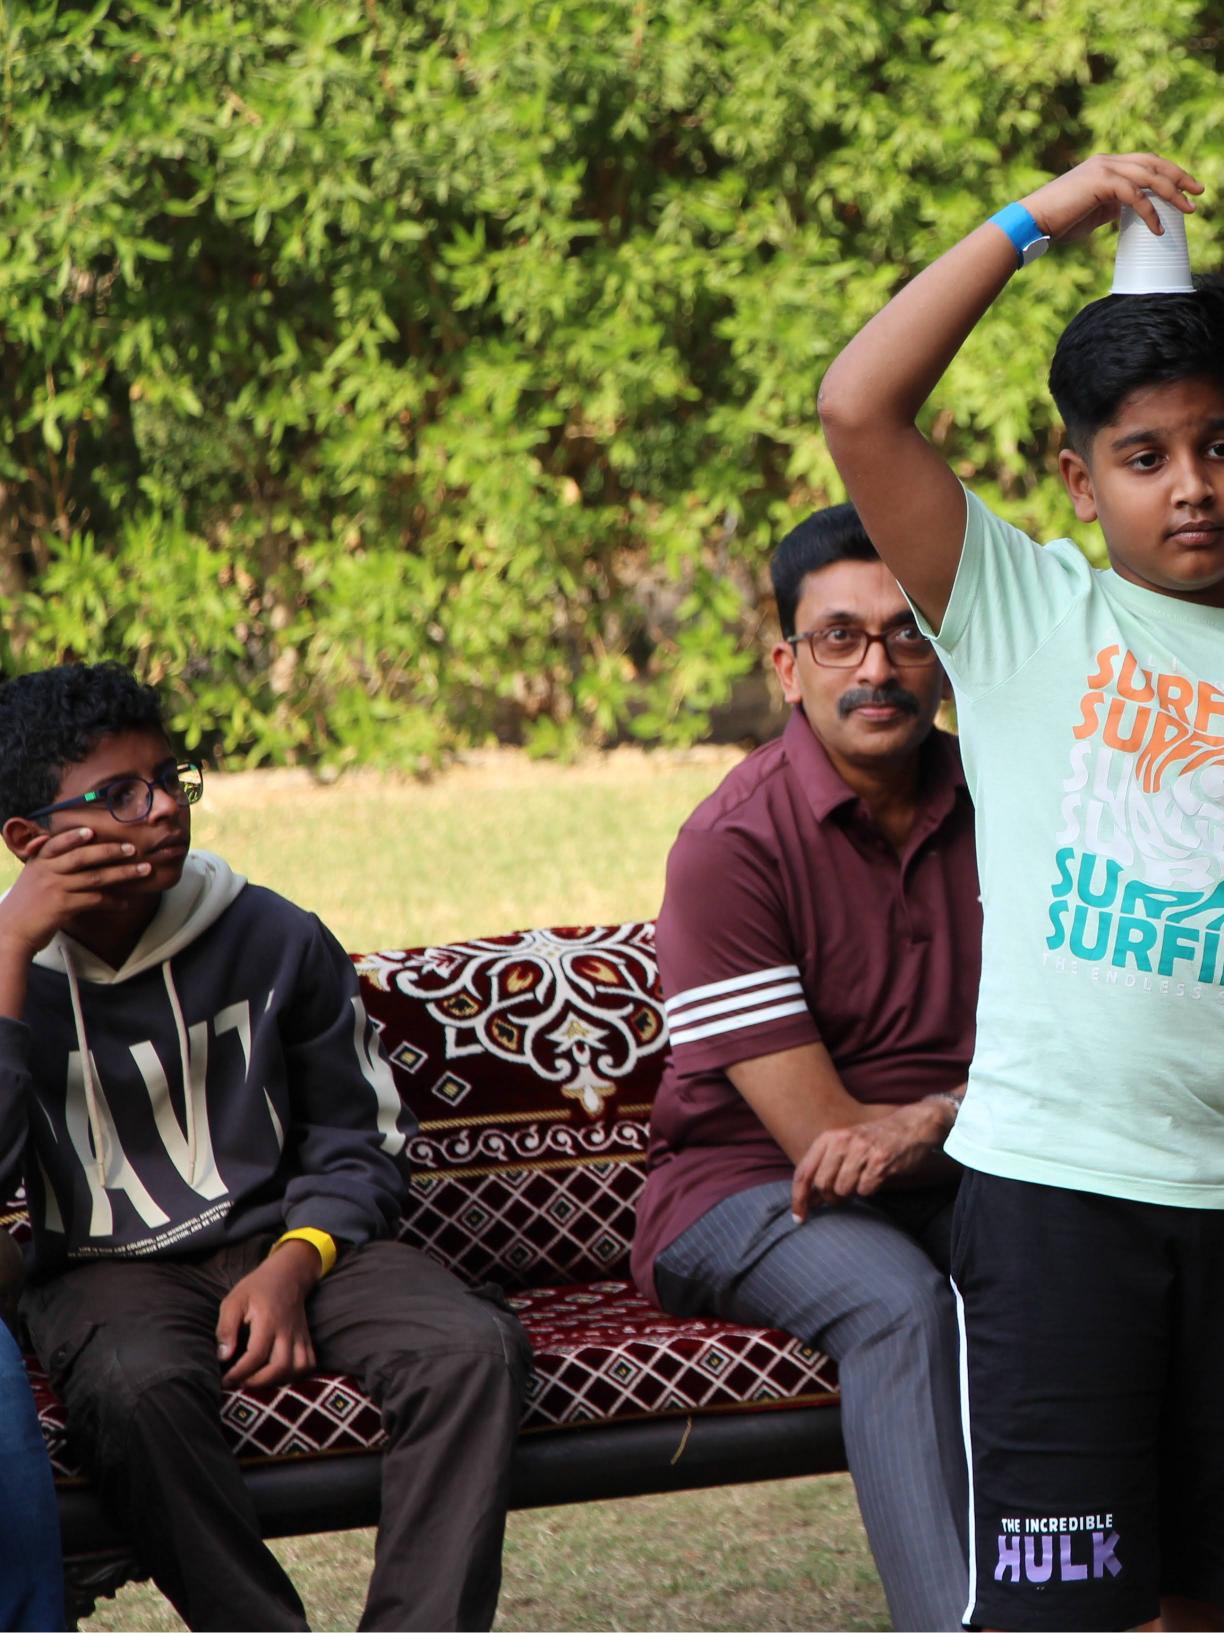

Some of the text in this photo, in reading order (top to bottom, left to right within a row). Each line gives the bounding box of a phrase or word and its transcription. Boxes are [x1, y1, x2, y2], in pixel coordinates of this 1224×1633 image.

[1042, 952, 1078, 976] THE
[1091, 967, 1201, 1000] ENDLESS
[1002, 1514, 1113, 1533] THE INCREDIBLE
[994, 1531, 1123, 1583] HULK
